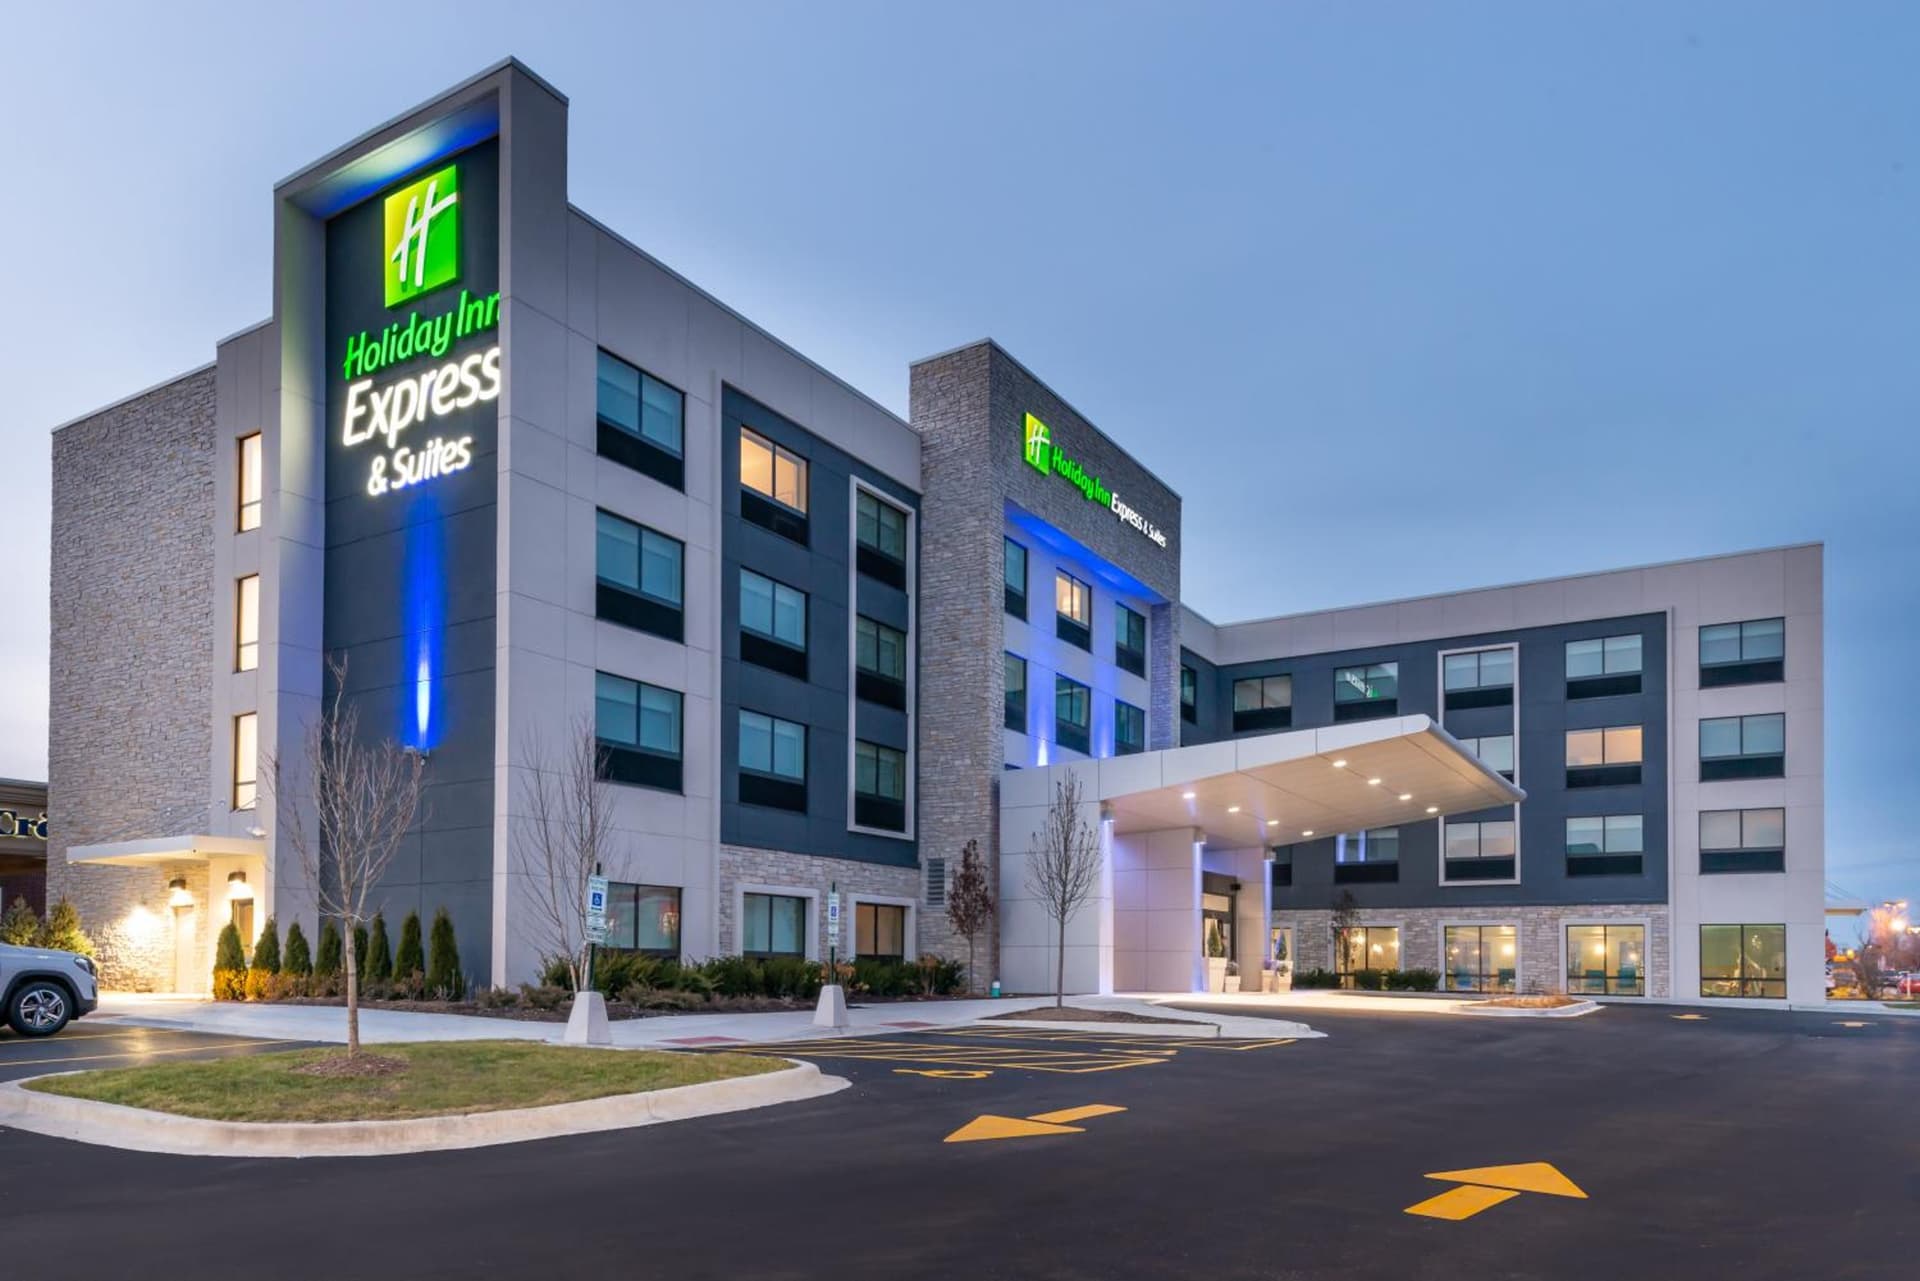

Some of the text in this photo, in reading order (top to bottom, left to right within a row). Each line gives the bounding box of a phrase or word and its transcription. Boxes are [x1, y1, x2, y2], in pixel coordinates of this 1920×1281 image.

[343, 289, 500, 381] Holiday Inn
[343, 346, 501, 449] Express
[367, 435, 472, 496] & Suites
[1052, 446, 1095, 500] Holiday
[1095, 476, 1111, 508] Inn
[1111, 491, 1143, 531] Express
[1148, 523, 1167, 548] Suites
